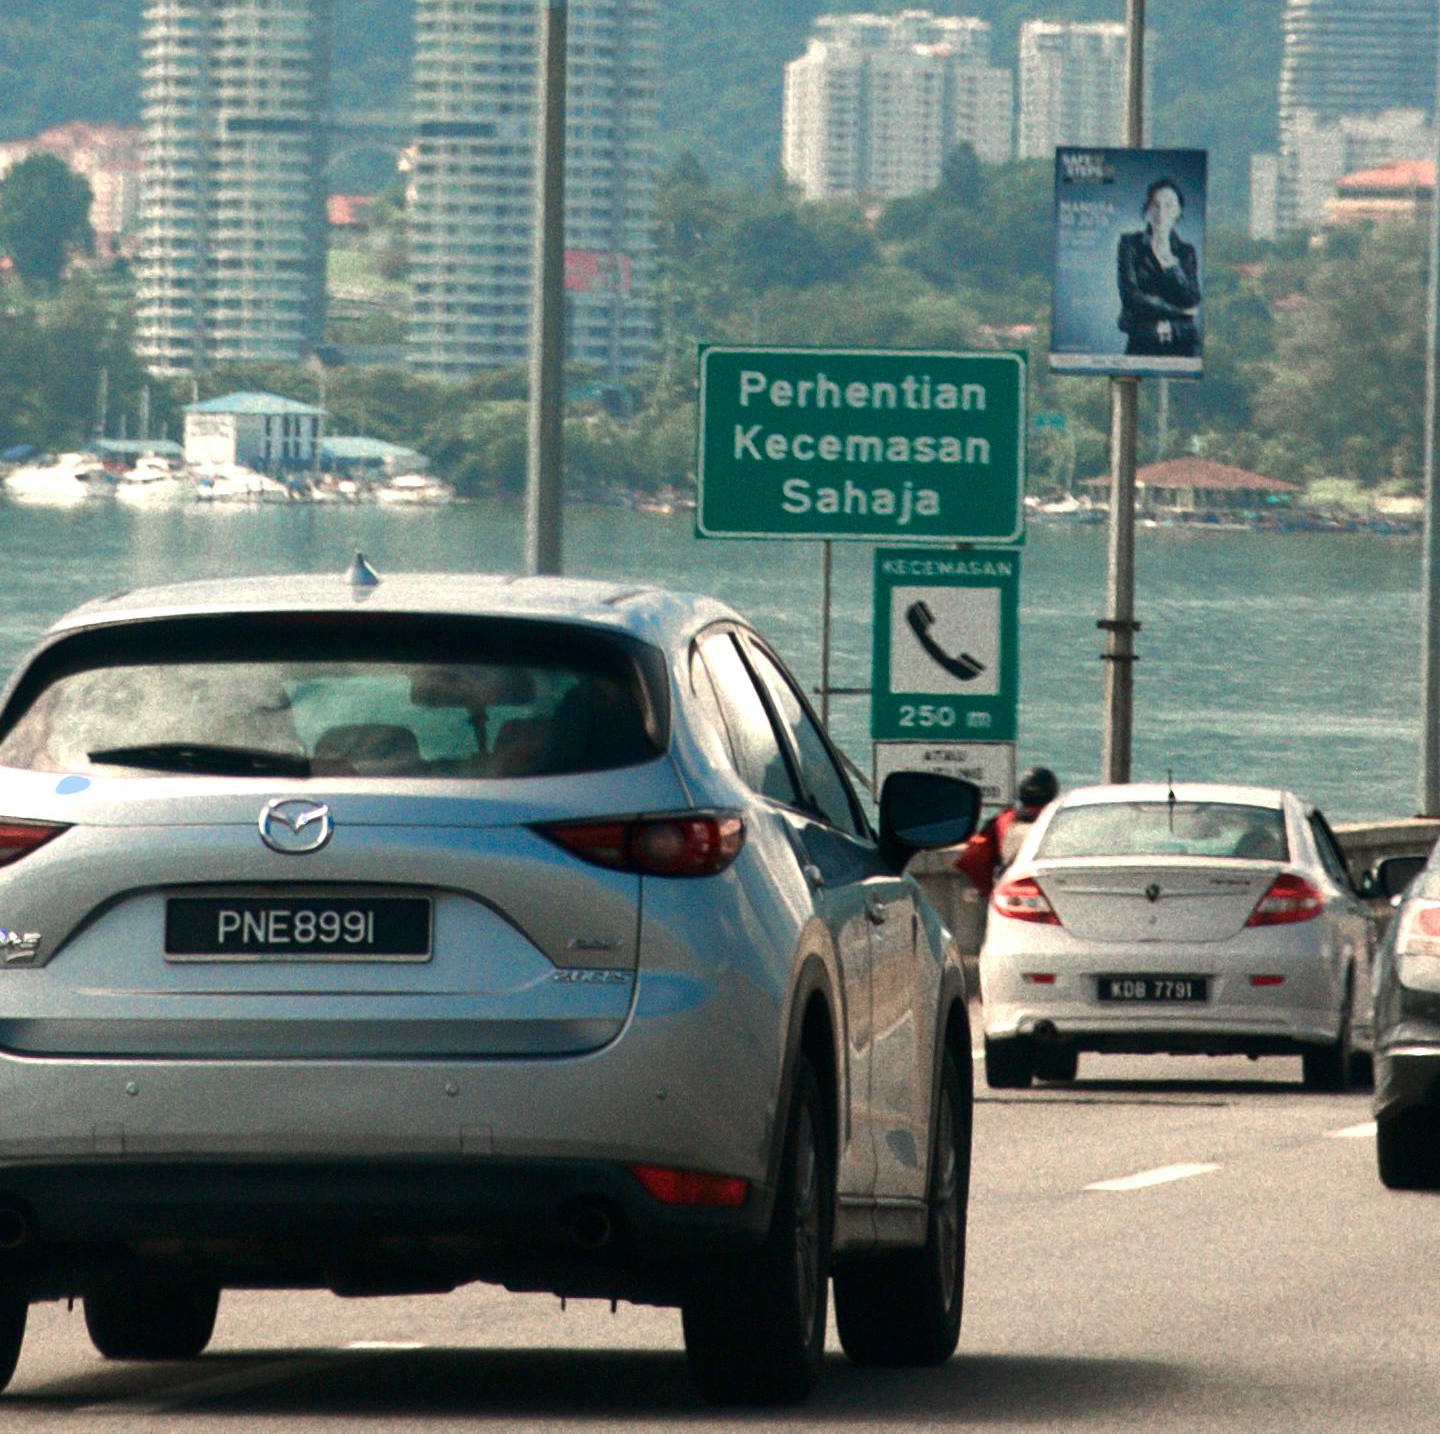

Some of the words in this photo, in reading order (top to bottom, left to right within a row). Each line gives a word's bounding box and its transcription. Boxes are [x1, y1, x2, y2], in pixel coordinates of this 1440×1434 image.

[739, 371, 987, 411] Perhentian
[733, 425, 991, 464] Kecemasan
[781, 479, 941, 525] Sahaja
[882, 560, 1013, 577] KECEMASAN
[898, 705, 956, 727] 250
[966, 709, 991, 728] m
[217, 909, 375, 944] PNE8991
[1109, 980, 1147, 999] KDB
[1154, 980, 1193, 999] 7791
